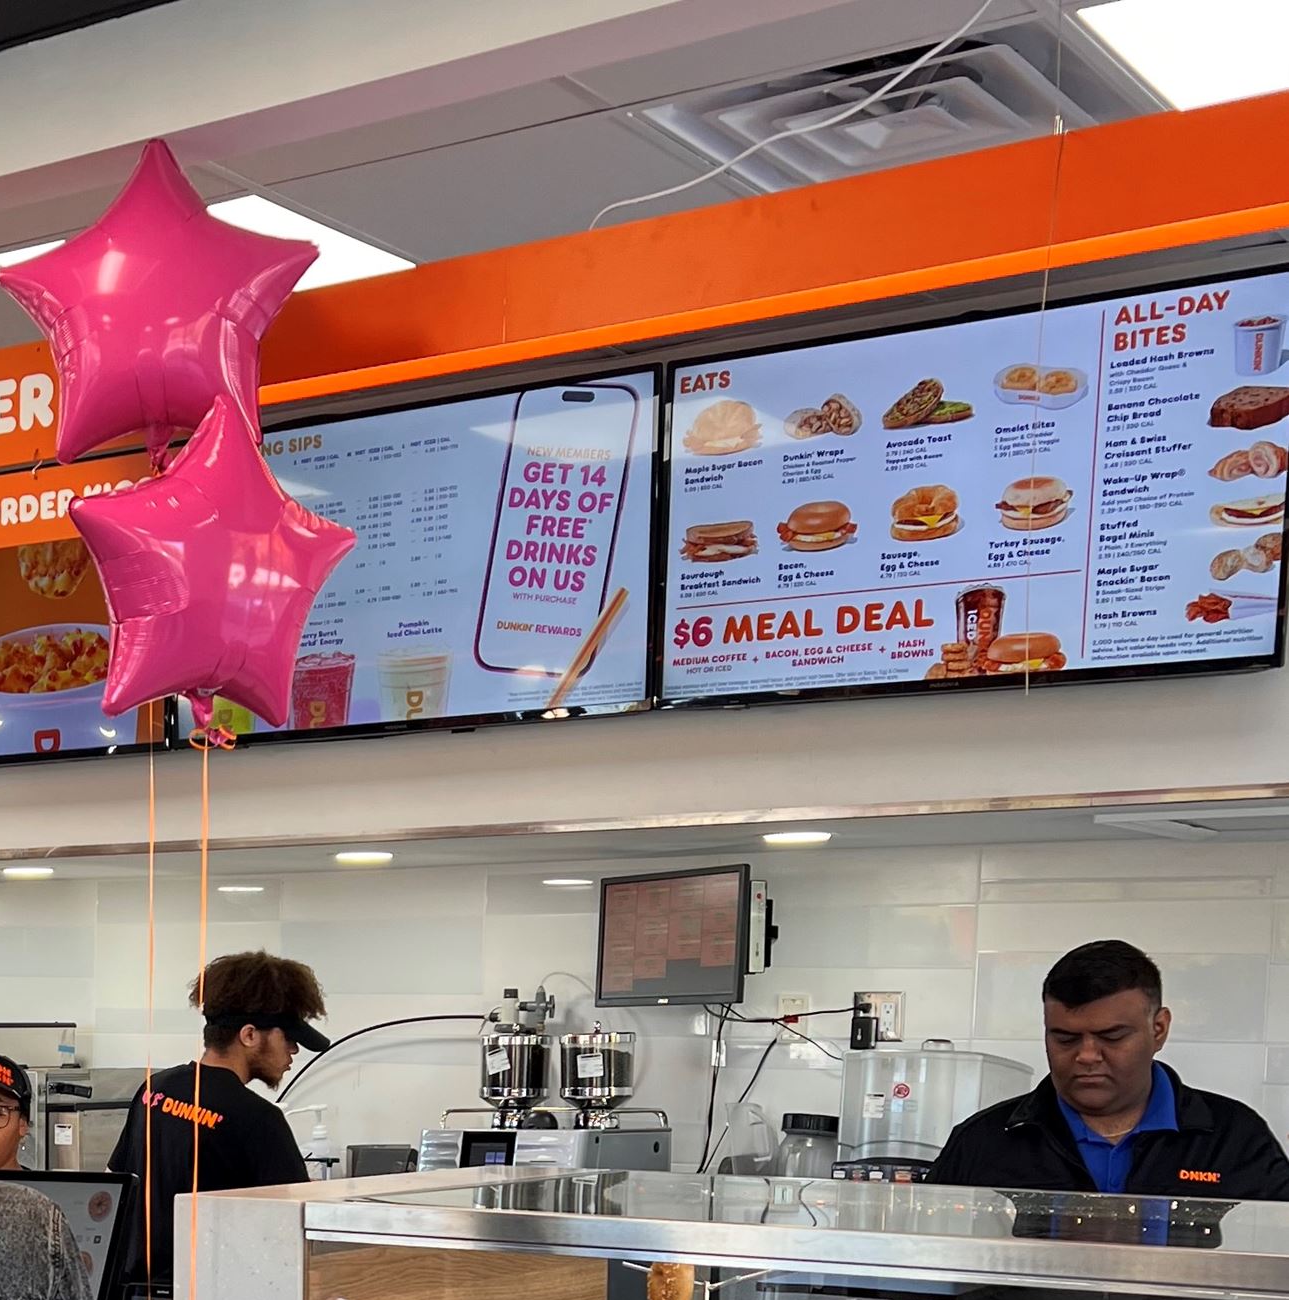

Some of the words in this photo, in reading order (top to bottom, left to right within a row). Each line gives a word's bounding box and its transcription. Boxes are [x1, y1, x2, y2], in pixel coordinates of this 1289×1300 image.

[1115, 290, 1230, 326] ALL-DAY
[1114, 323, 1186, 352] BITES
[680, 370, 731, 394] EATS
[1107, 400, 1145, 411] Banana
[1148, 393, 1200, 405] Chocolate
[995, 424, 1029, 434] Omelet
[288, 434, 322, 453] SIPS
[886, 438, 925, 448] Avocado
[927, 434, 952, 443] Toast
[1104, 448, 1152, 460] Croissant
[1155, 443, 1193, 453] Stuffer
[524, 461, 574, 484] GET
[580, 465, 606, 487] 14
[685, 474, 723, 485] Sandwich
[1103, 474, 1148, 486] Wake-Up
[1102, 486, 1149, 497] Sandwich
[508, 487, 571, 511] DAYS
[578, 491, 614, 514] OF
[505, 540, 598, 566] DRINKS
[988, 552, 1005, 562] Egg
[1007, 551, 1014, 559] &
[1016, 547, 1051, 558] Cheese
[880, 562, 896, 572] Egg
[907, 559, 940, 568] Cheese
[1097, 567, 1127, 576] Maple
[1130, 563, 1160, 573] Sugar
[508, 566, 547, 589] ON
[553, 569, 586, 592] US
[680, 570, 724, 580] Sourdough
[777, 572, 793, 582] Egg
[795, 572, 801, 580] &
[803, 569, 834, 578] Cheese
[680, 581, 719, 591] Breakfast
[722, 577, 761, 587] Sandwich
[513, 592, 533, 601] WITH
[535, 594, 577, 605] PURCHASE
[398, 620, 430, 629] Pumpkin
[496, 620, 534, 632] DUNKIN'
[535, 624, 582, 637] REWARDS
[673, 616, 713, 649] $6
[722, 609, 824, 645] MEAL
[837, 599, 934, 634] DEAL
[967, 609, 978, 640] ICED
[765, 649, 802, 659] BACON,
[804, 648, 825, 656] EGG
[835, 643, 873, 653] CHEESE
[898, 639, 926, 649] HASH
[672, 656, 709, 667] MEDIUM
[712, 653, 748, 663] COFFEE
[791, 656, 845, 667] SANDWICH
[891, 649, 934, 660] BROWNS
[715, 665, 732, 673] ICED
[162, 1097, 224, 1128] DUNKIN'
